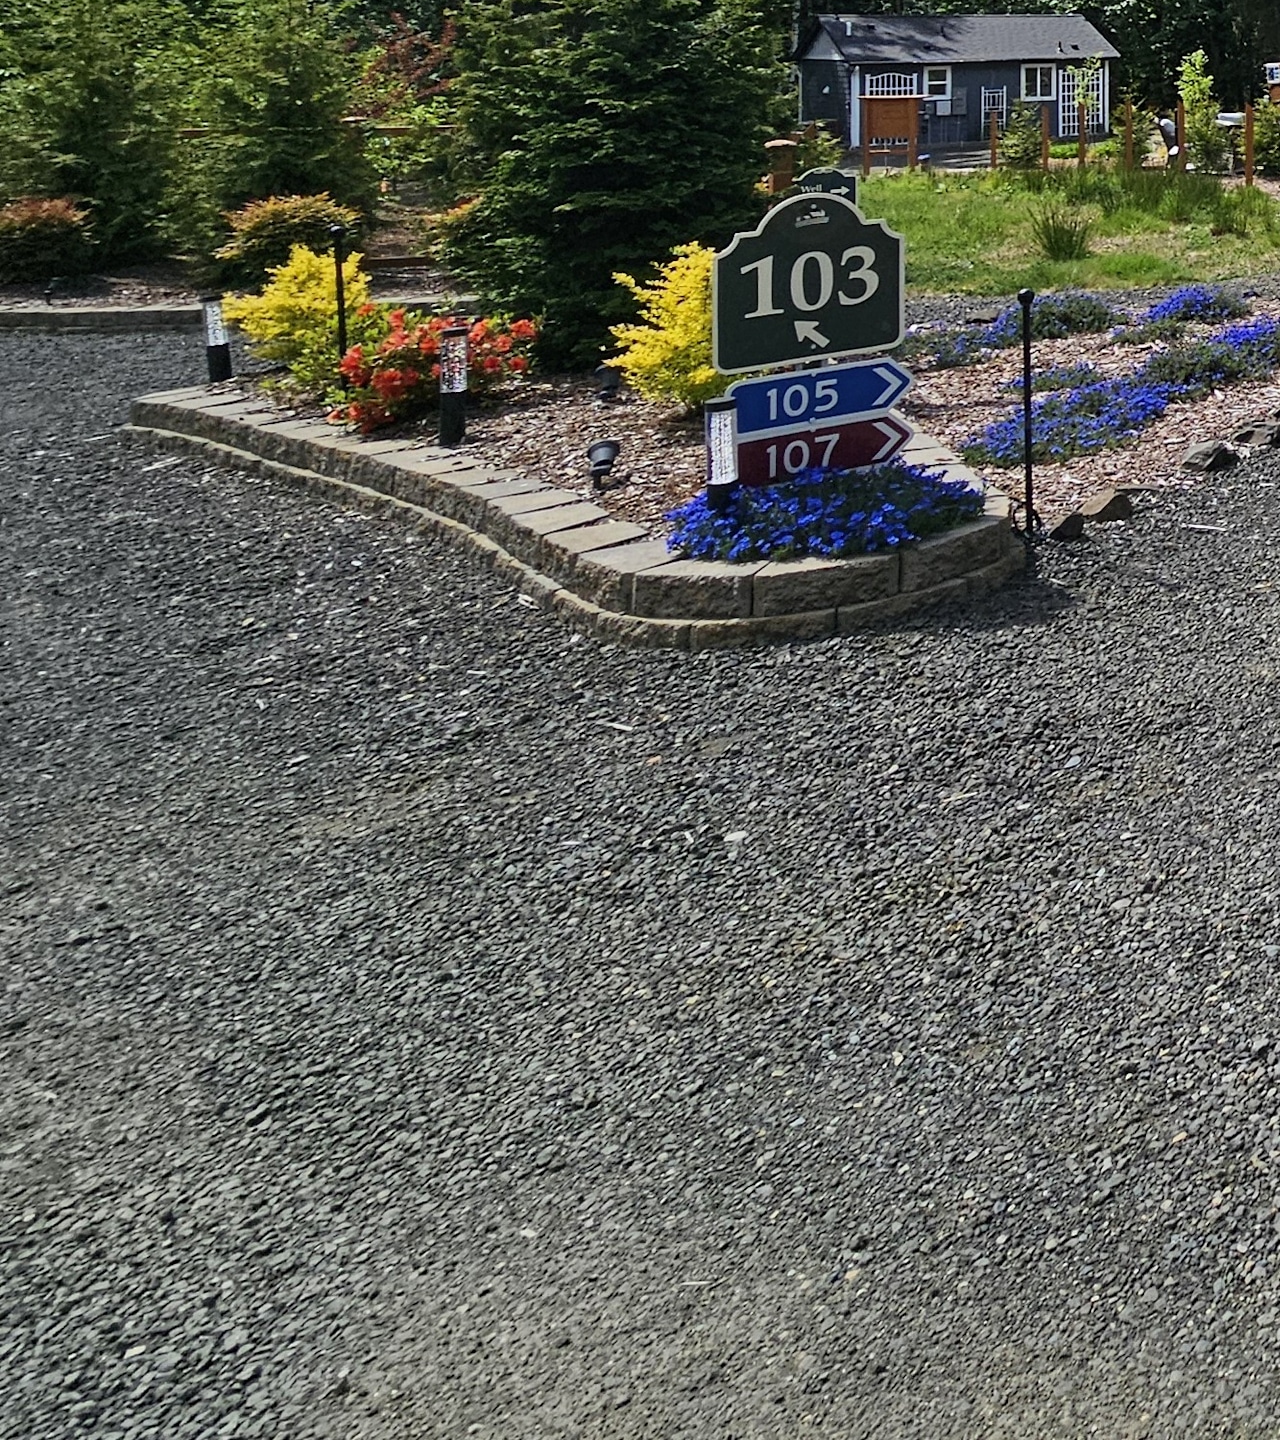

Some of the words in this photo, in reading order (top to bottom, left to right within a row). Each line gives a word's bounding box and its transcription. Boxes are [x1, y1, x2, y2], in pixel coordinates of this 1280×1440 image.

[801, 184, 823, 193] Well
[740, 246, 880, 319] 103
[766, 379, 839, 421] 105
[766, 434, 840, 478] 107
